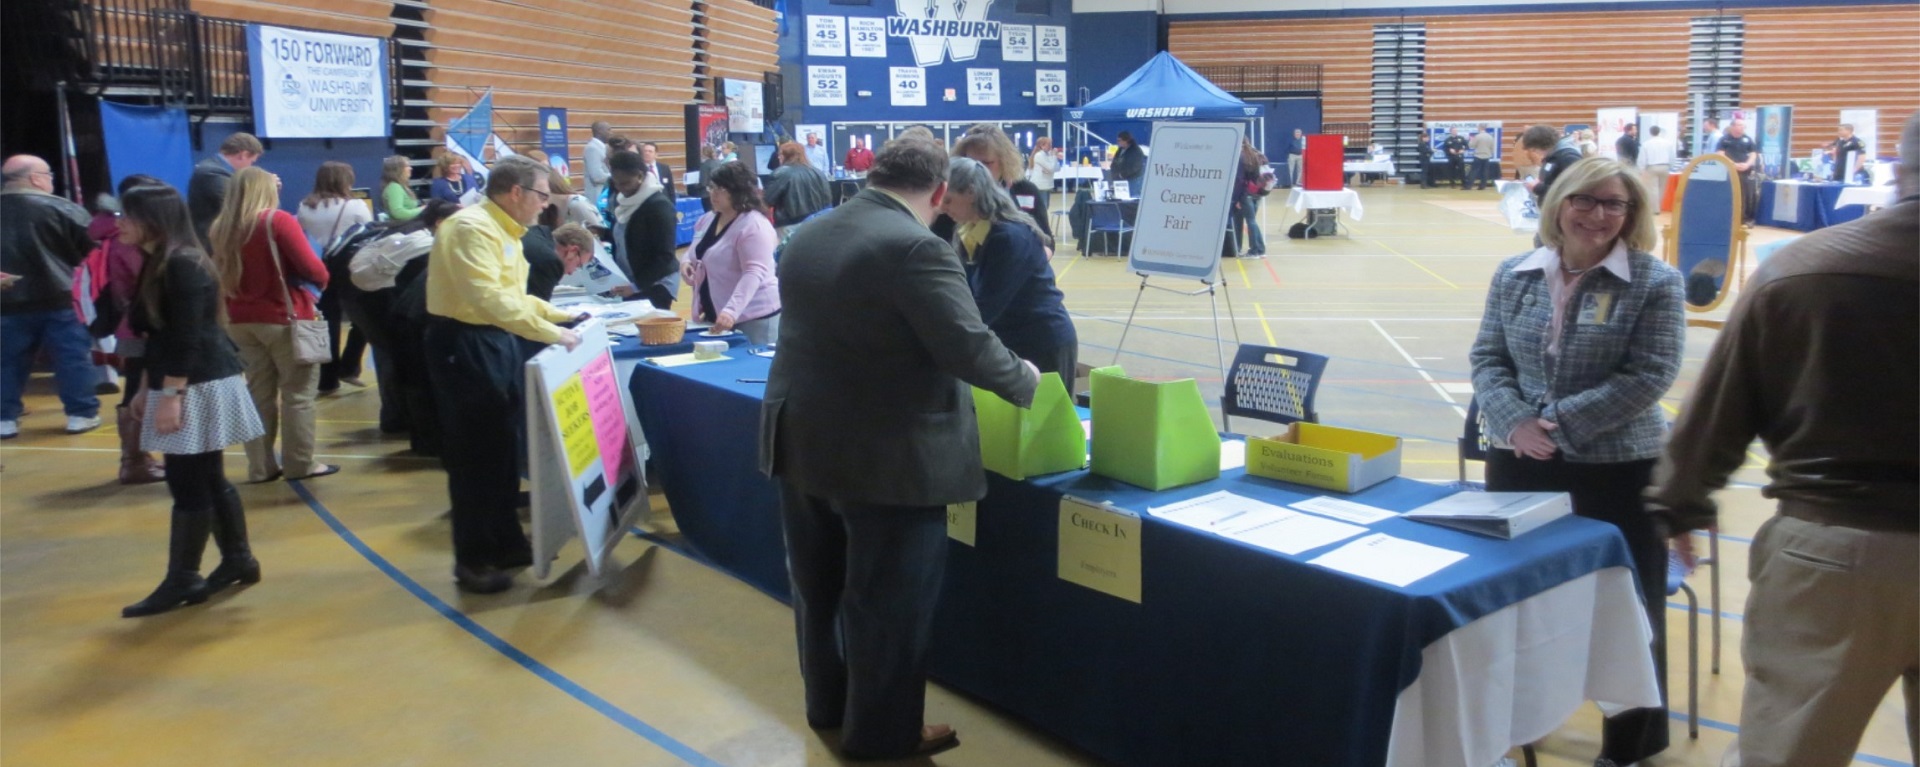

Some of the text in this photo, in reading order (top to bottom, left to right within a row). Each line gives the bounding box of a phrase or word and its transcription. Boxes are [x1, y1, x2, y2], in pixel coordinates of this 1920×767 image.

[889, 16, 1000, 38] WASHBURN
[816, 30, 837, 39] 45
[858, 32, 878, 41] 35
[1009, 37, 1026, 45] 54
[1042, 38, 1060, 46] 23
[271, 38, 372, 67] 150 FORWARD
[307, 79, 373, 95] WASHBURN
[817, 80, 838, 89] 52
[898, 80, 918, 89] 40
[975, 82, 993, 91] 14
[1044, 84, 1060, 93] 10
[309, 98, 375, 113] UNIVERSITY
[1126, 107, 1195, 118] WASHBURN
[1174, 142, 1203, 151] Welcome
[1154, 163, 1223, 180] Washburn
[1160, 189, 1206, 205] Career
[1163, 215, 1192, 231] Fair
[565, 400, 579, 419] JOB
[1261, 445, 1334, 468] Evaluations
[1260, 461, 1335, 482] Volunteer Forms
